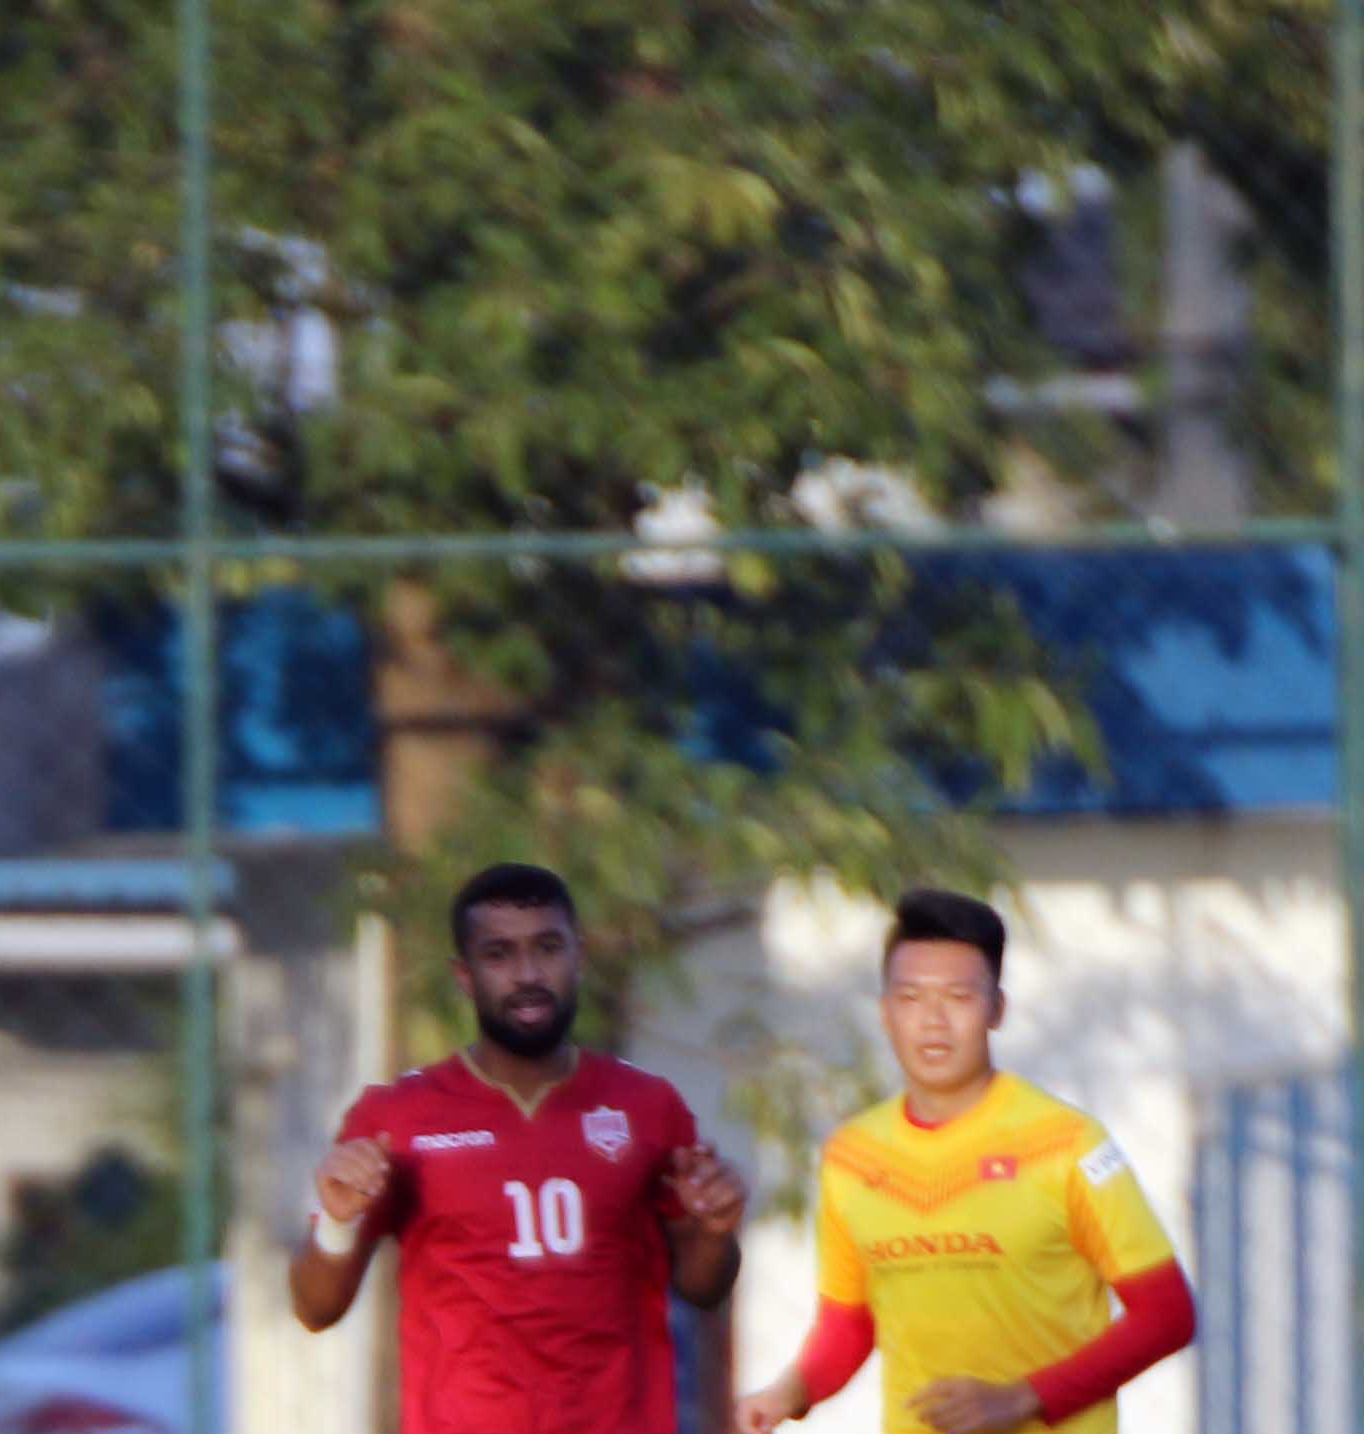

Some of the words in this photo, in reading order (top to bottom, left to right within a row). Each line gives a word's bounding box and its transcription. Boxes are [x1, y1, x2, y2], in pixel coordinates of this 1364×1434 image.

[411, 1130, 495, 1152] macron
[504, 1179, 582, 1258] 10
[867, 1231, 1004, 1263] HONDA
